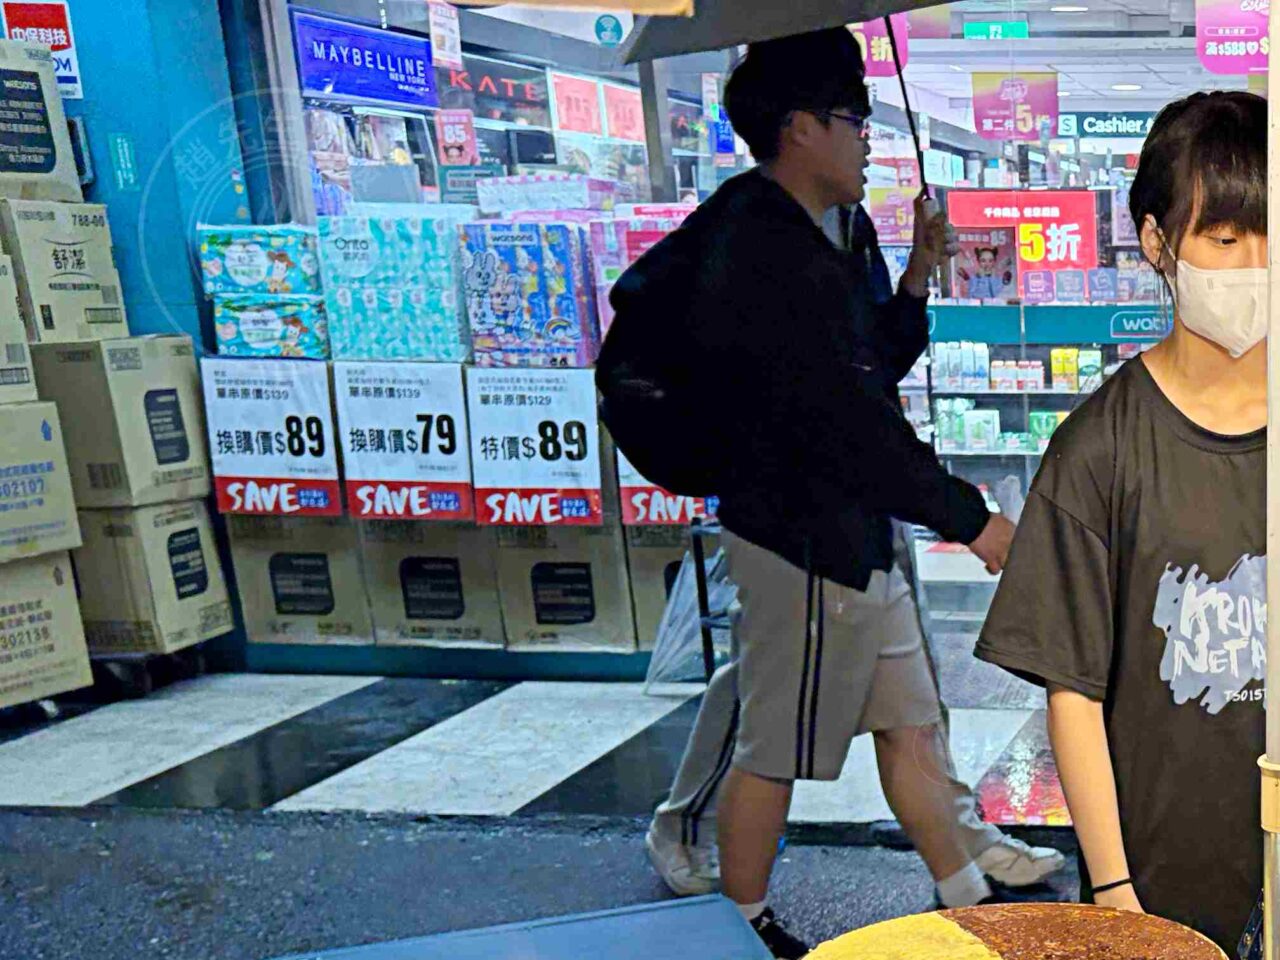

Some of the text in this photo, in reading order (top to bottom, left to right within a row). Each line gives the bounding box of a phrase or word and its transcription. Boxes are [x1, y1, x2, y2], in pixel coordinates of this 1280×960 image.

[312, 41, 426, 77] MAYBELLINE
[450, 69, 541, 101] KATE
[1083, 117, 1143, 134] Cashier
[1019, 223, 1081, 262] 5折
[226, 480, 301, 512] SAVE
[356, 484, 431, 515] SAVE
[485, 492, 562, 523] SAVE
[631, 491, 707, 523] SAVE
